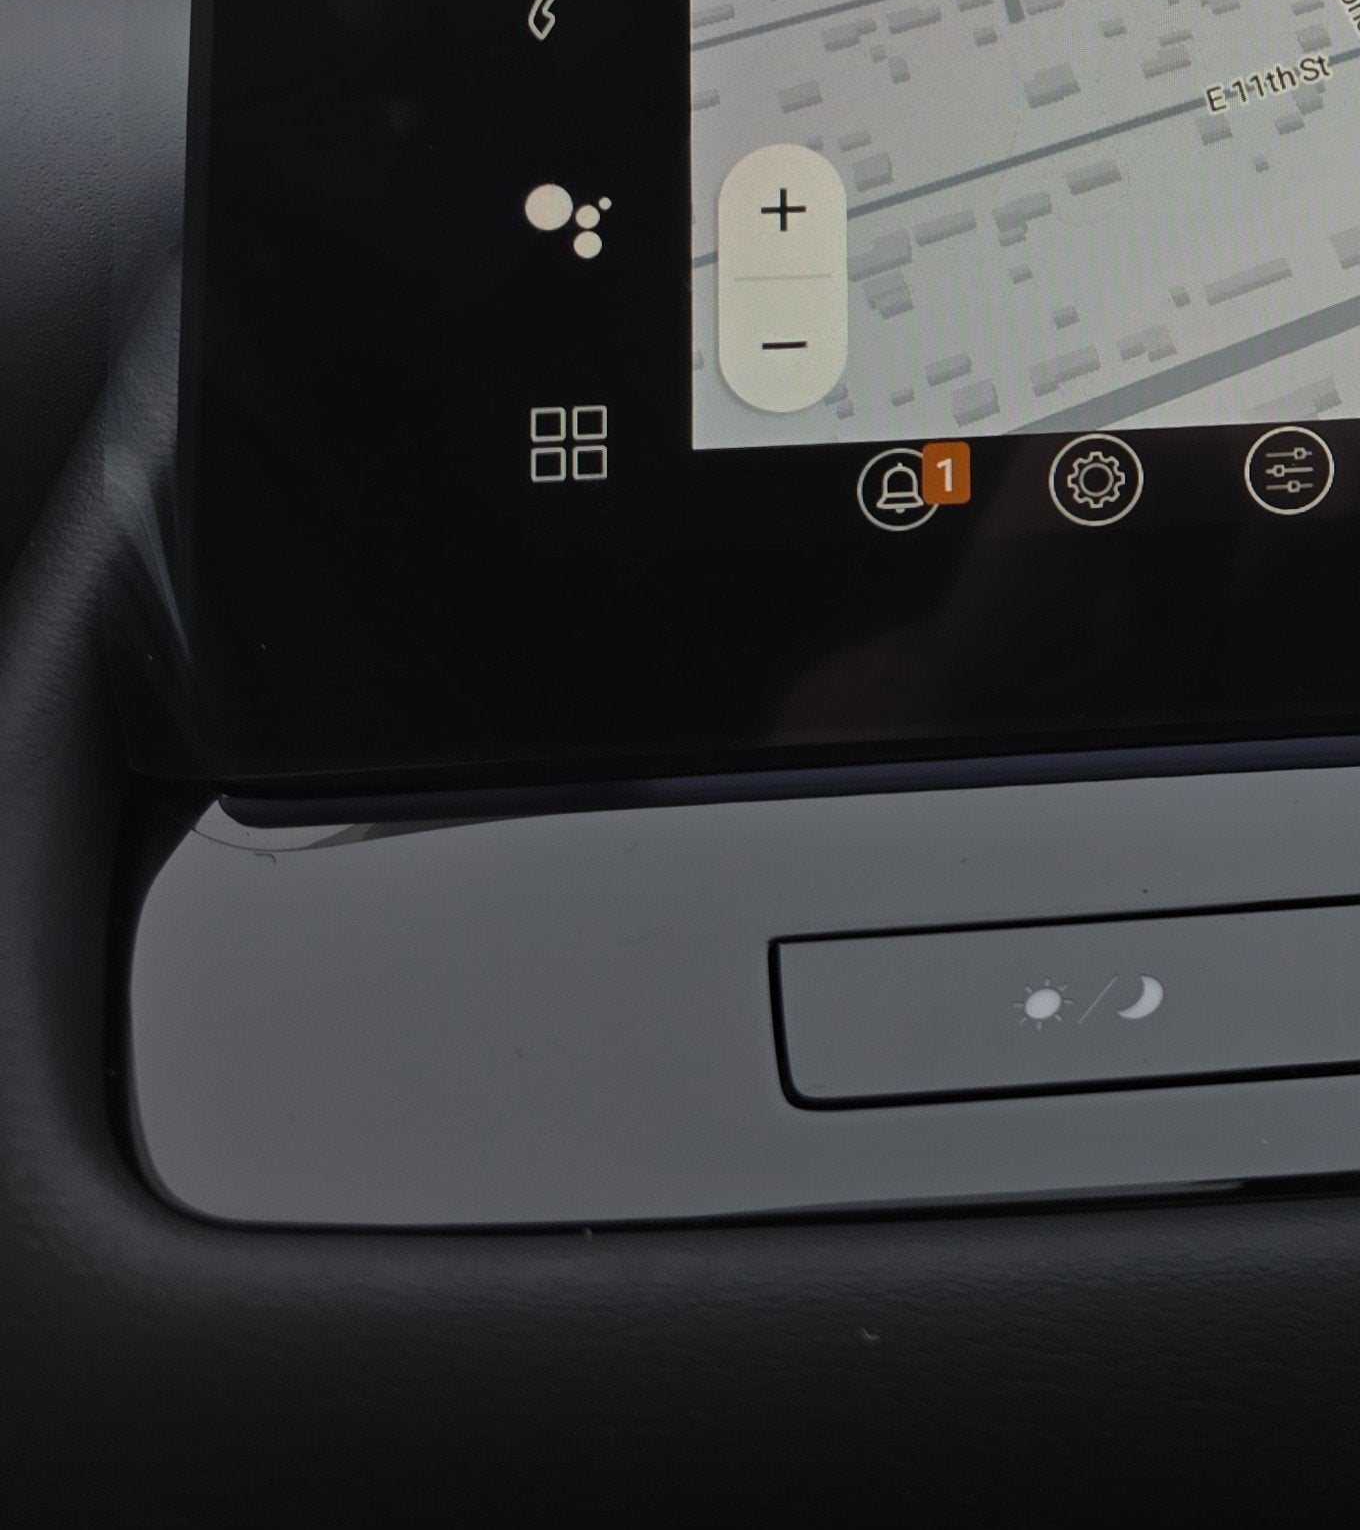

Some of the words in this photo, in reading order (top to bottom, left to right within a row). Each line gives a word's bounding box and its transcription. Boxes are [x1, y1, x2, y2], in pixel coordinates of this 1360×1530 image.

[1206, 86, 1227, 112] E
[1232, 66, 1296, 104] 11th
[1299, 56, 1330, 82] St
[936, 458, 955, 492] 1
